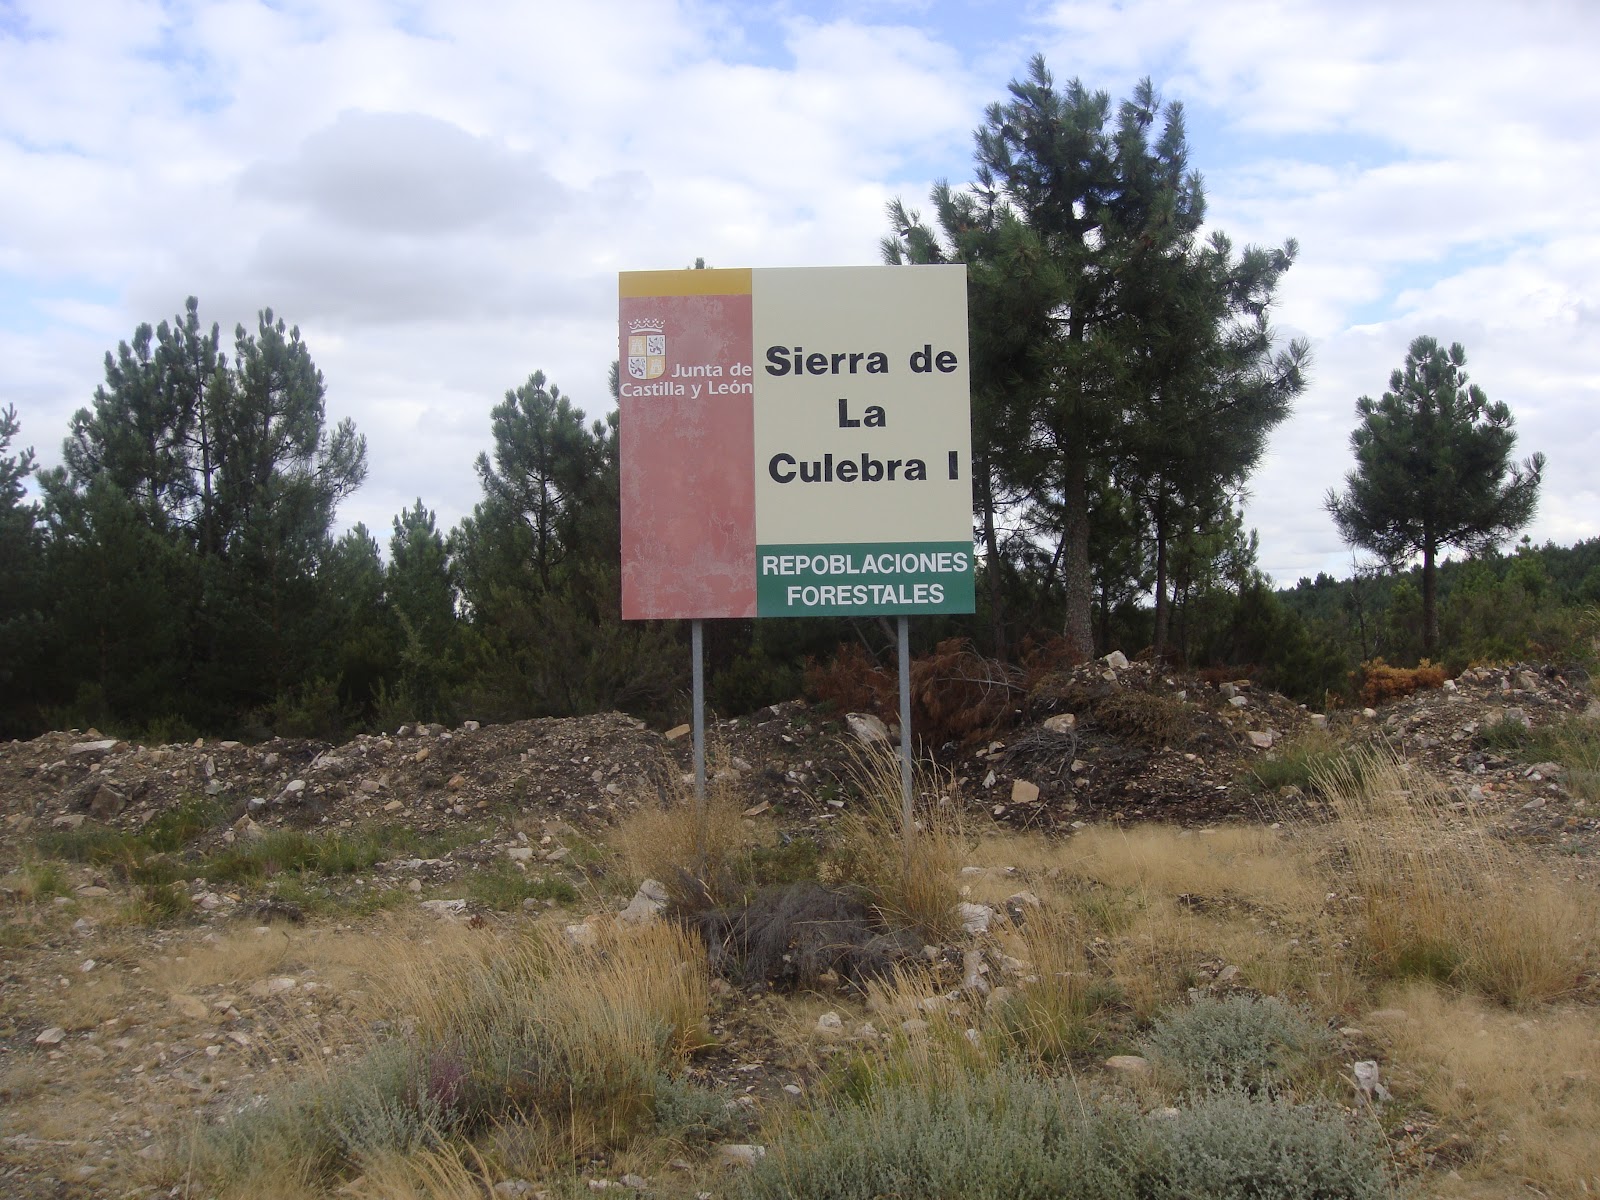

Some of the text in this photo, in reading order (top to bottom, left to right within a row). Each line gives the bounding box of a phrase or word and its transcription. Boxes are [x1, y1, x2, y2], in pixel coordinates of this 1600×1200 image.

[671, 362, 752, 378] Junta de
[765, 344, 957, 376] Sierra de
[620, 380, 753, 399] Castilla y León
[839, 399, 886, 428] La
[769, 452, 927, 483] Culebra
[762, 552, 968, 576] REPOBLACIONES
[786, 583, 945, 607] FORESTALES
